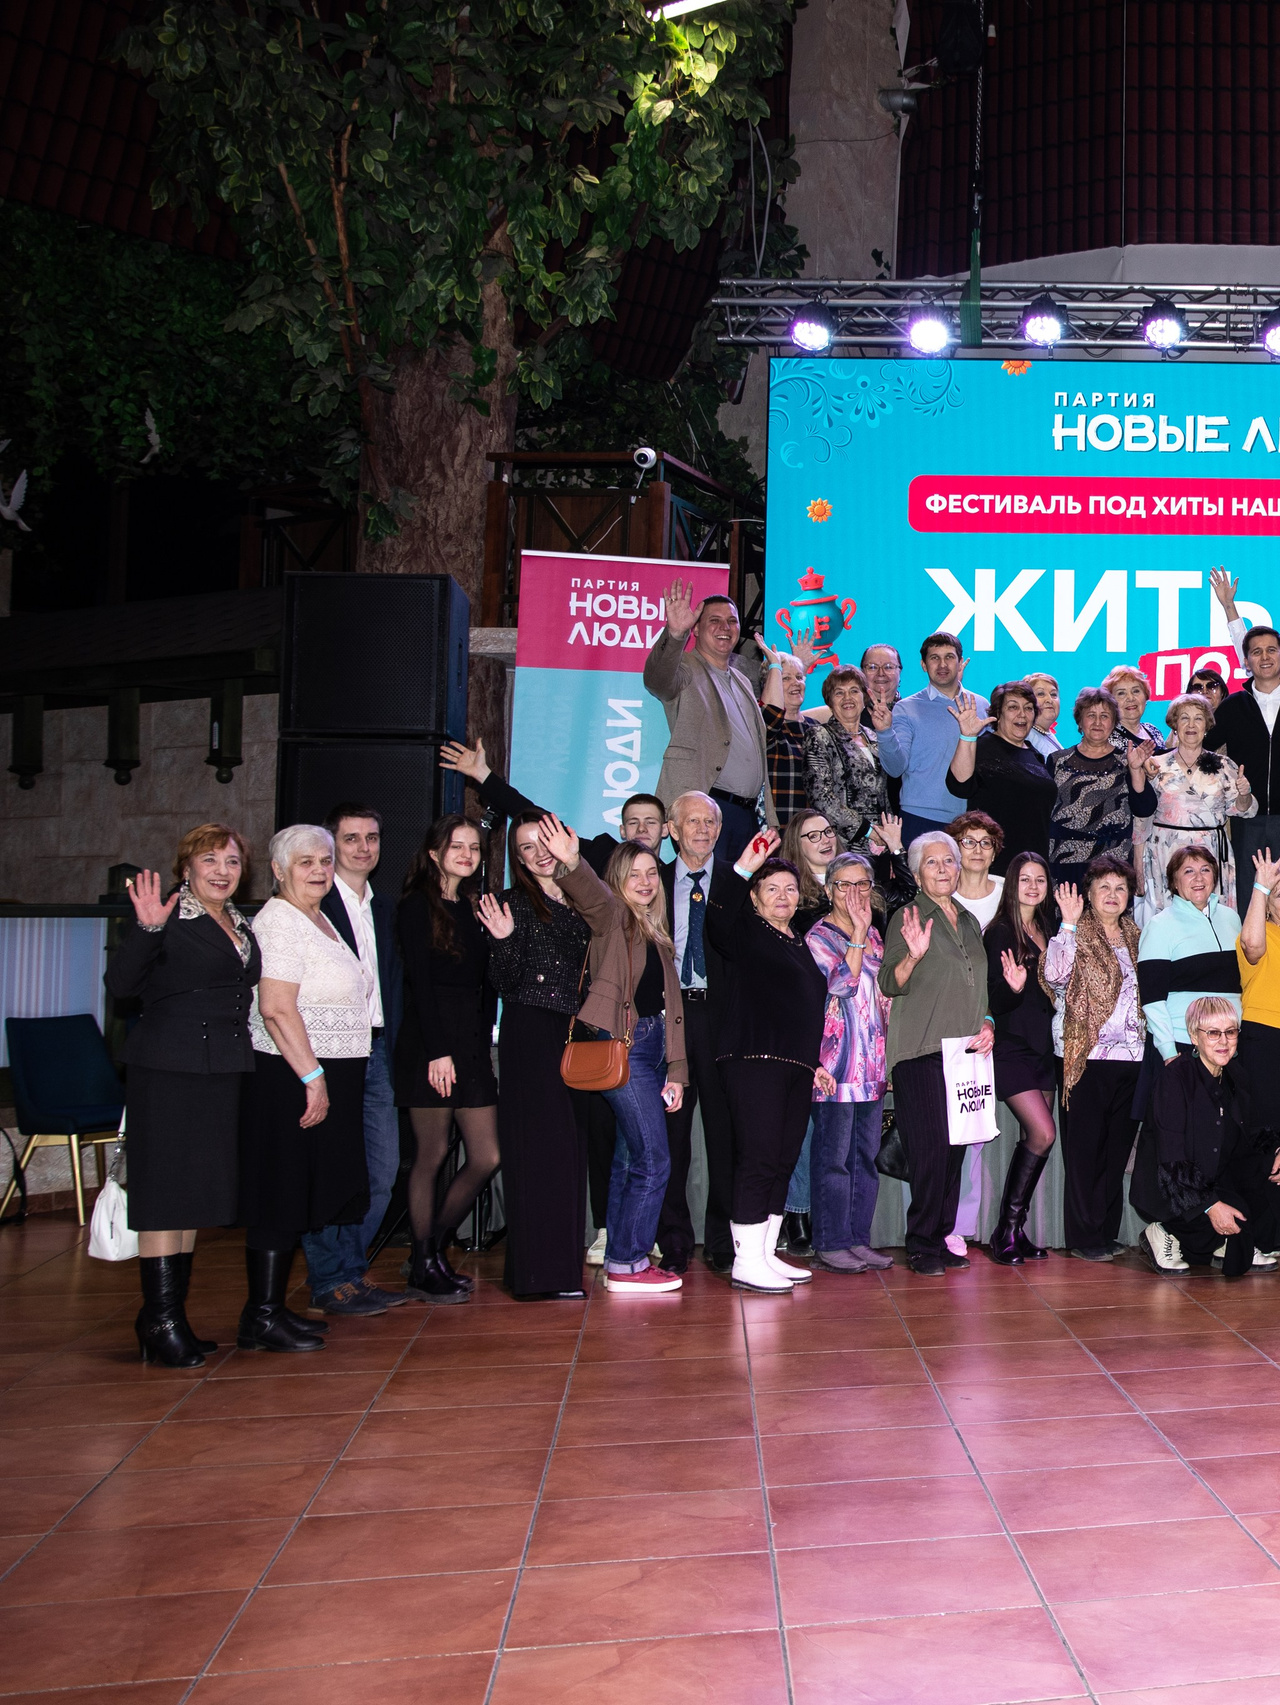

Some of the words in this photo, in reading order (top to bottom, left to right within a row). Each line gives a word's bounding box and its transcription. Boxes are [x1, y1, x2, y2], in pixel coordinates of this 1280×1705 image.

[1054, 391, 1155, 408] ПАРТИЯ
[1052, 413, 1231, 453] НОВЫЕ
[925, 493, 1082, 515] ФЕСТИВАЛЬ
[1088, 495, 1147, 519] ПОД
[1151, 496, 1225, 516] ХИТЫ
[571, 577, 640, 592] ПАРТИЯ
[569, 591, 667, 622] НОВЫ
